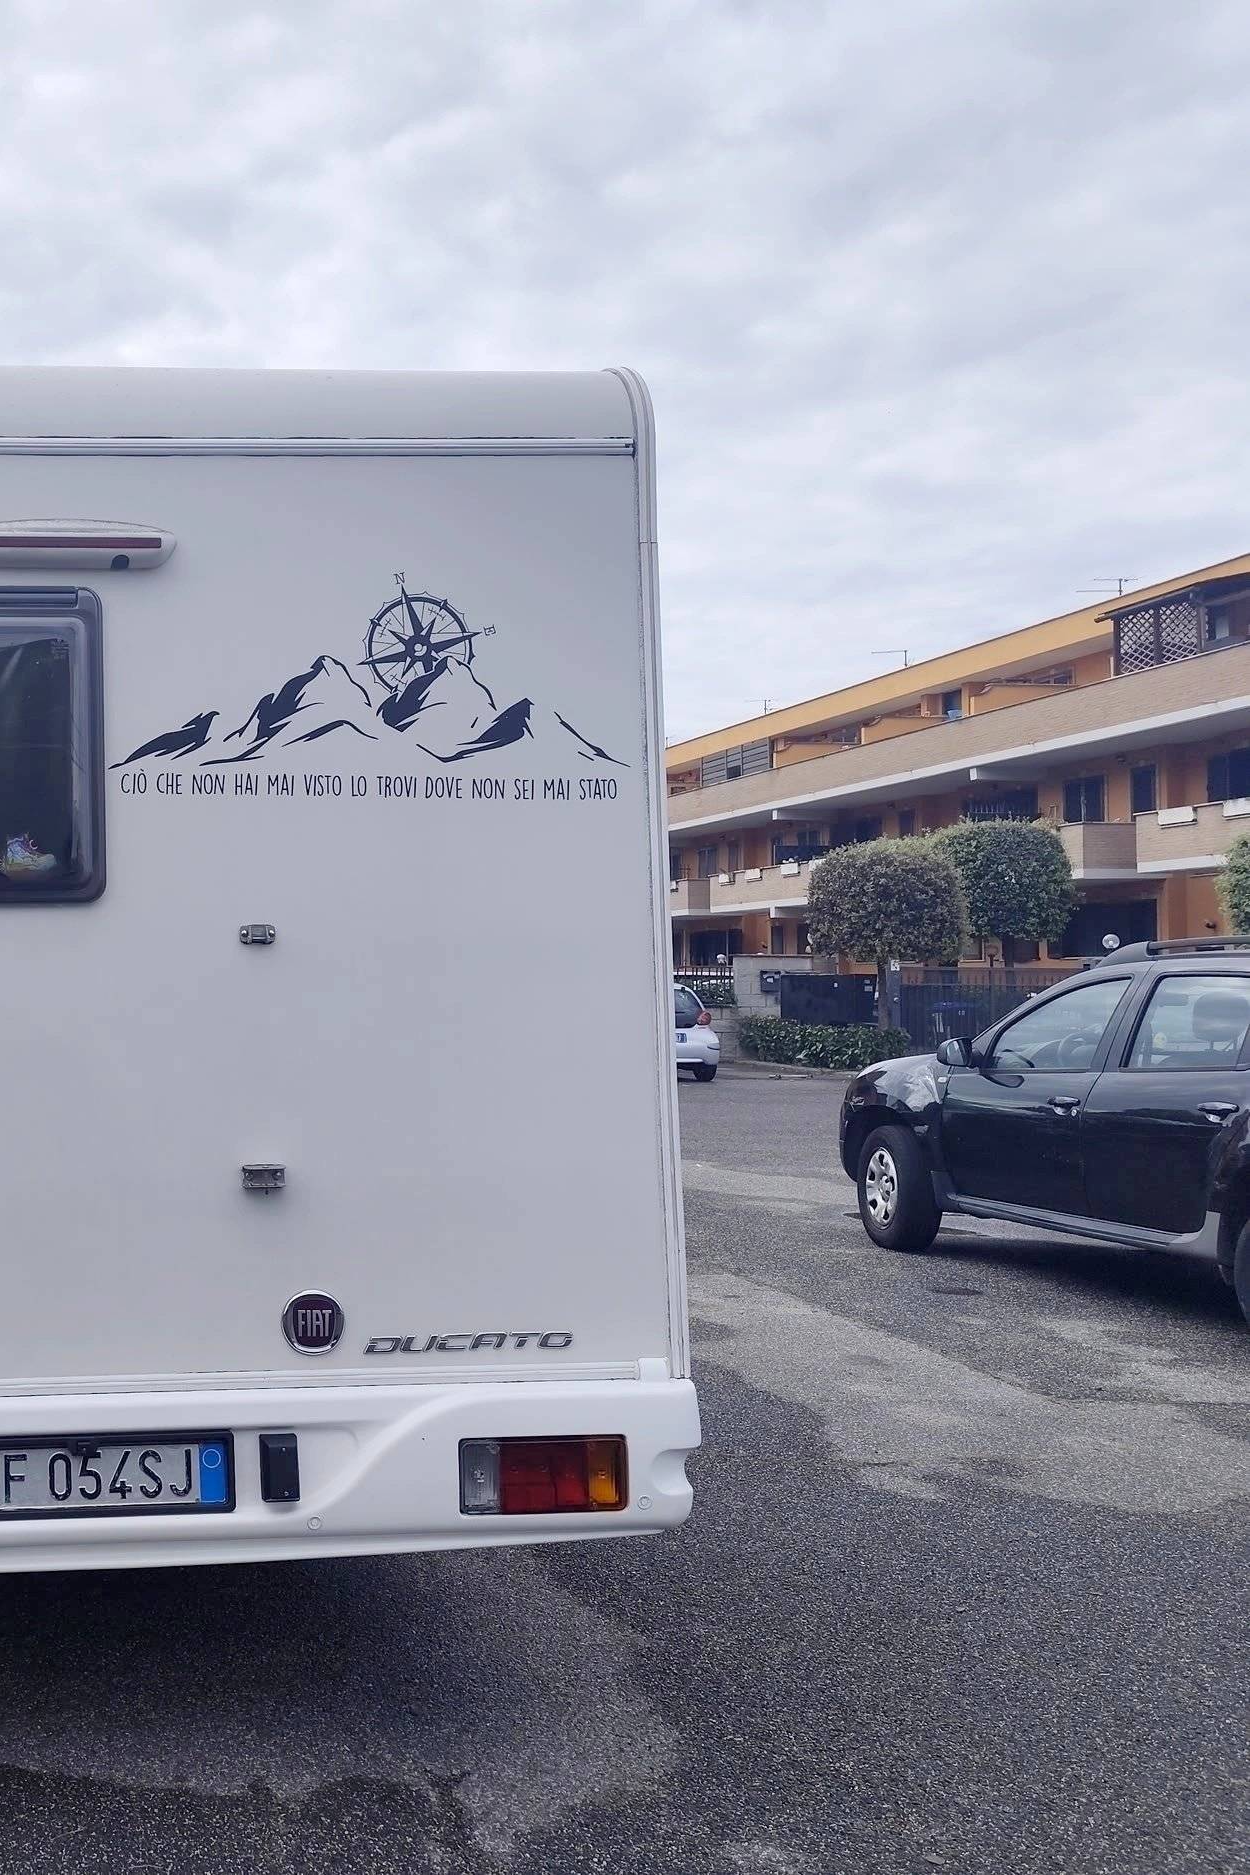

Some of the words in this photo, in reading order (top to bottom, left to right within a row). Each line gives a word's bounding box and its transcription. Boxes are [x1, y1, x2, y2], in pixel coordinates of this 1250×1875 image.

[120, 768, 148, 795] CIÒ
[156, 773, 183, 795] CHE
[192, 773, 226, 795] NON
[234, 773, 259, 796] HAI
[267, 773, 295, 797] MAI
[304, 774, 342, 797] VISTO
[351, 775, 367, 797] LO
[376, 776, 417, 799] TROVI
[425, 776, 463, 799] DOVE
[472, 777, 505, 800] NON
[514, 778, 535, 800] SEI
[543, 778, 570, 800] MAI
[579, 778, 618, 800] STATO
[297, 1309, 332, 1337] FIAT
[363, 1331, 573, 1355] DUCATO
[48, 1449, 192, 1501] 054SJ
